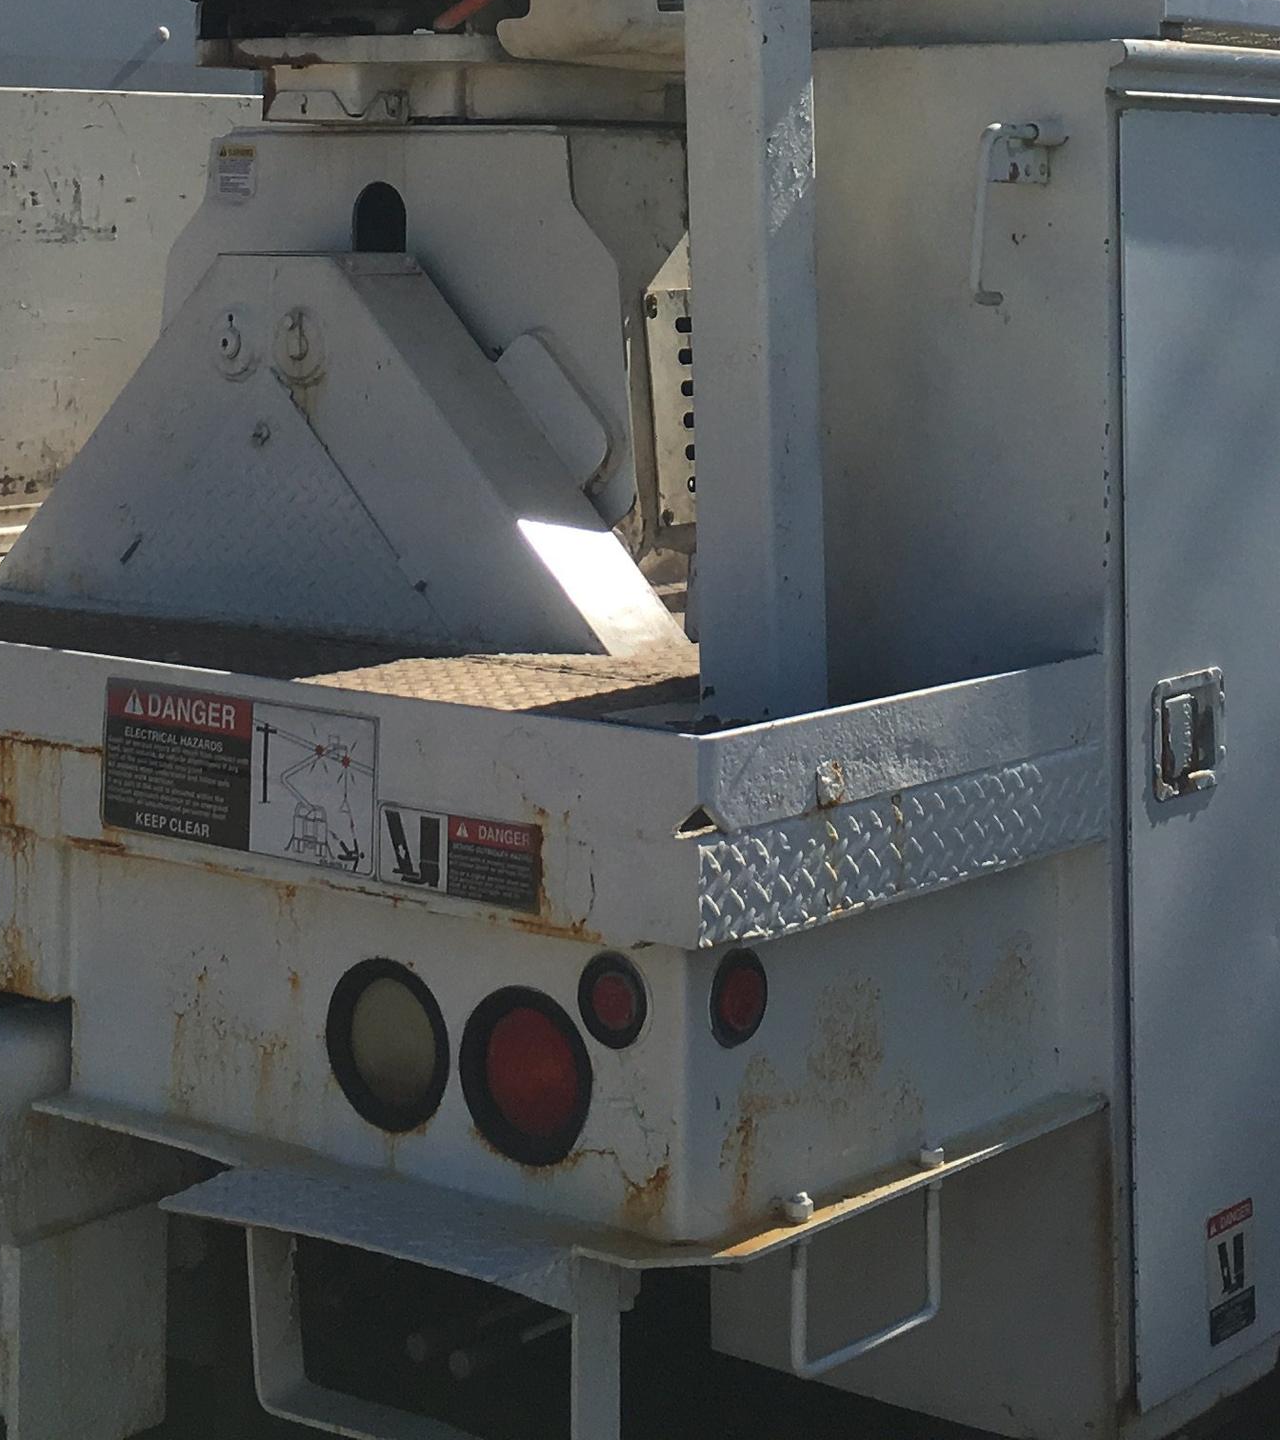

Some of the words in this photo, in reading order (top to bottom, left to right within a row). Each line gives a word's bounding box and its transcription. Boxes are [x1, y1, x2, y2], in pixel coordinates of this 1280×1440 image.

[147, 693, 236, 730] DANGER
[124, 726, 178, 745] ELECTRICAL
[180, 736, 223, 753] HAZARDS
[135, 811, 167, 829] KEEP
[169, 817, 210, 838] CLEAR
[478, 824, 531, 847] DANGER
